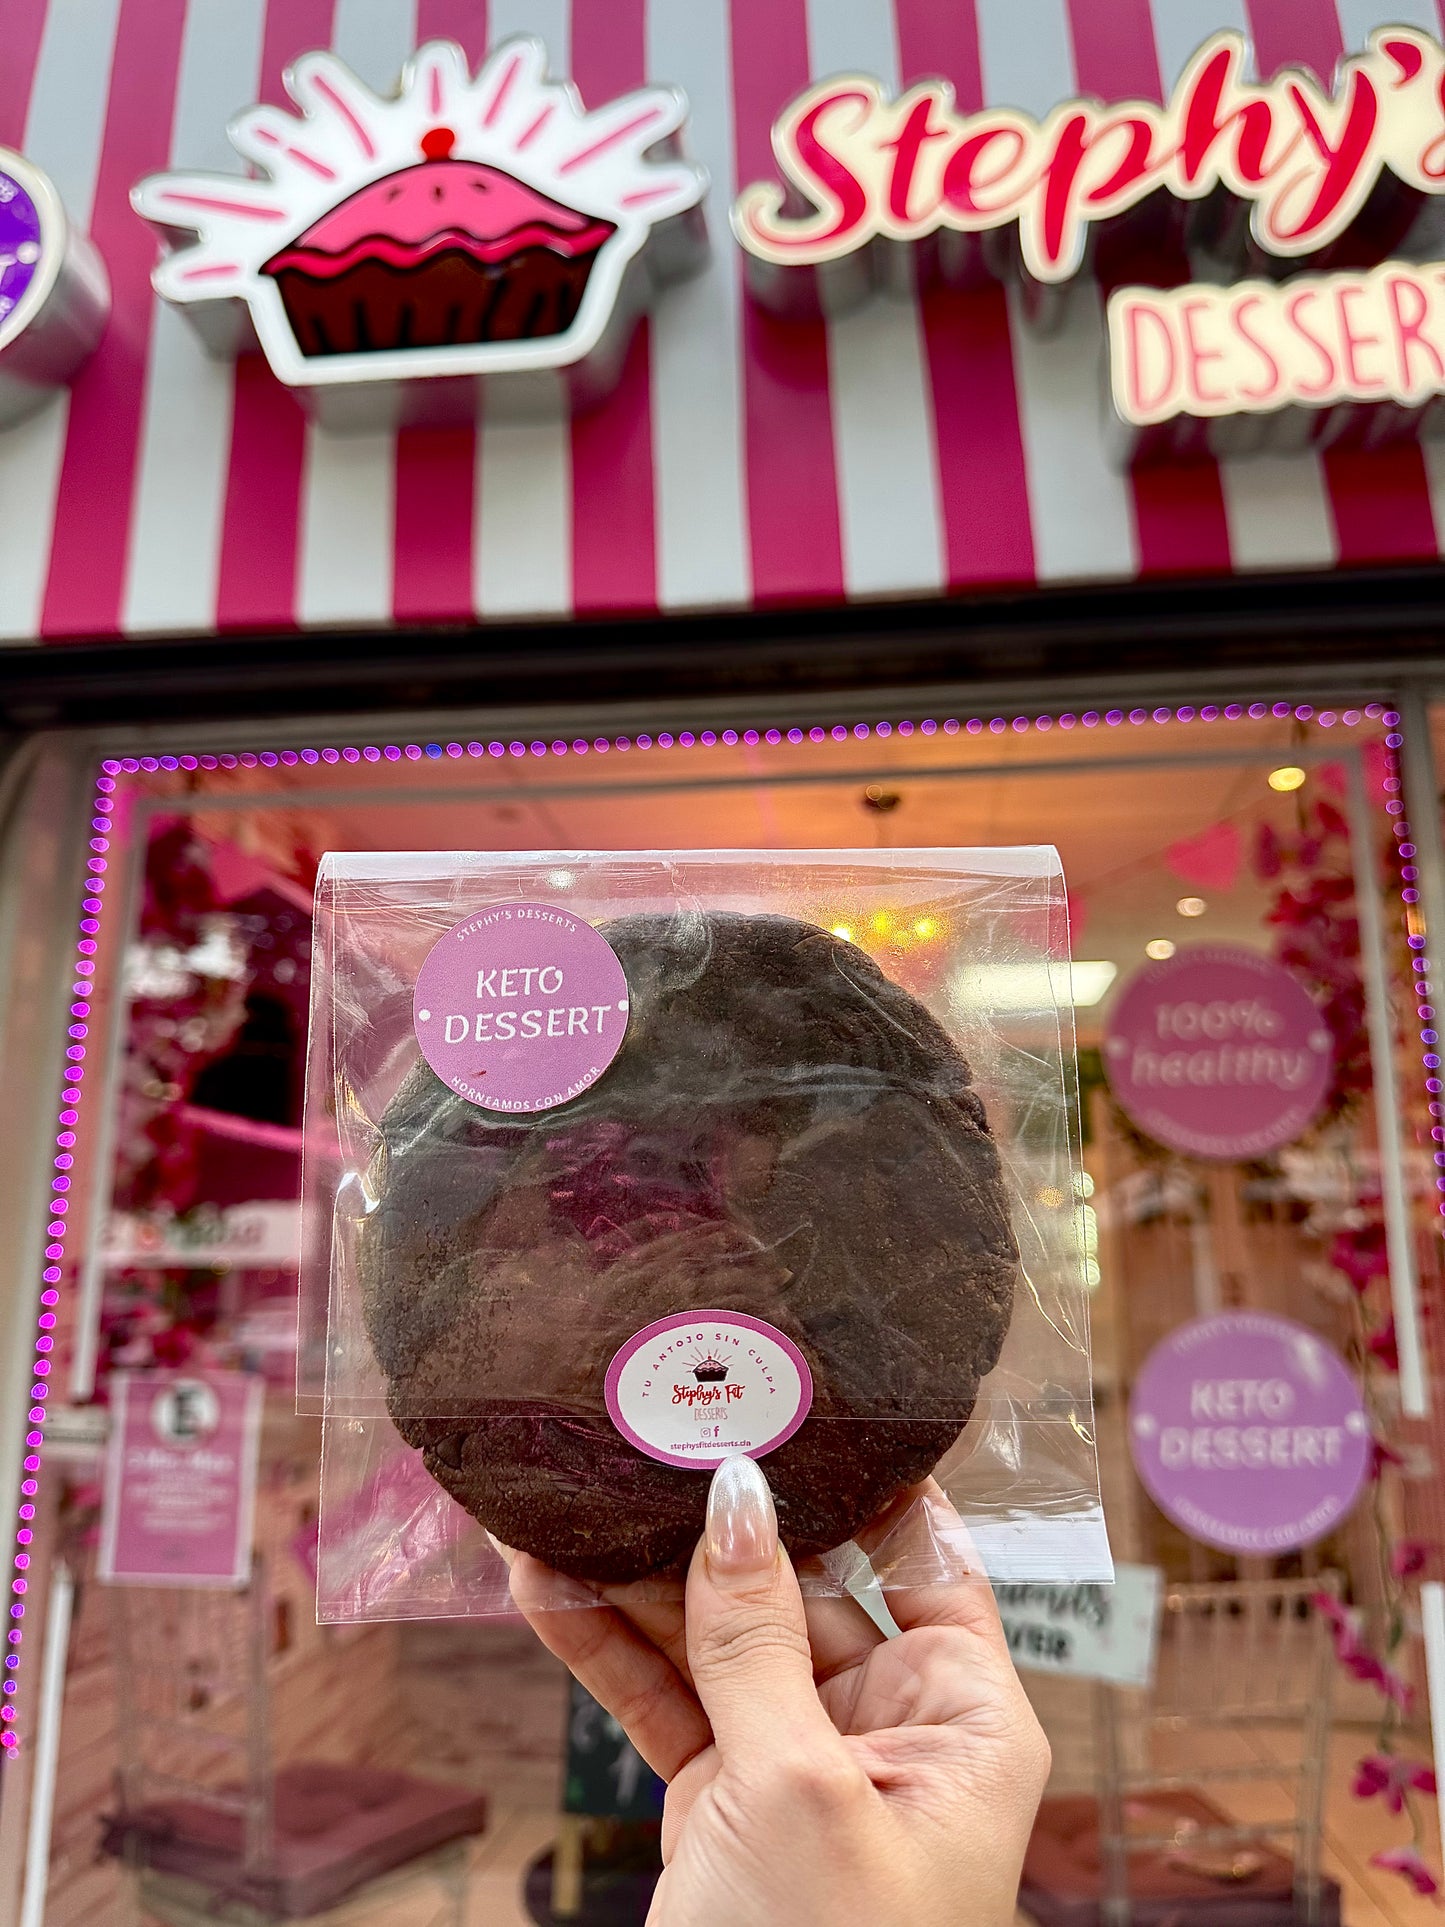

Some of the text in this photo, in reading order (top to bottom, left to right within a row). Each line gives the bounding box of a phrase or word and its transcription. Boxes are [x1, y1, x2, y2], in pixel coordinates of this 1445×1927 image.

[1122, 272, 1445, 413] DESSER
[456, 908, 577, 942] STEPHY'S DESSERTS
[475, 965, 564, 999] KETO
[444, 1005, 612, 1044] DESSERT
[1156, 997, 1284, 1041] 100%
[1131, 1040, 1310, 1091] healthy
[451, 1065, 602, 1110] HORNEAMOS CON AMOR
[642, 1332, 777, 1398] TU ANTOJO SIN CULPA
[671, 1383, 746, 1406] Stephy's Fit
[694, 1406, 728, 1421] DESSERTS
[1190, 1378, 1296, 1421] KETO
[1160, 1426, 1343, 1471] DESSERT
